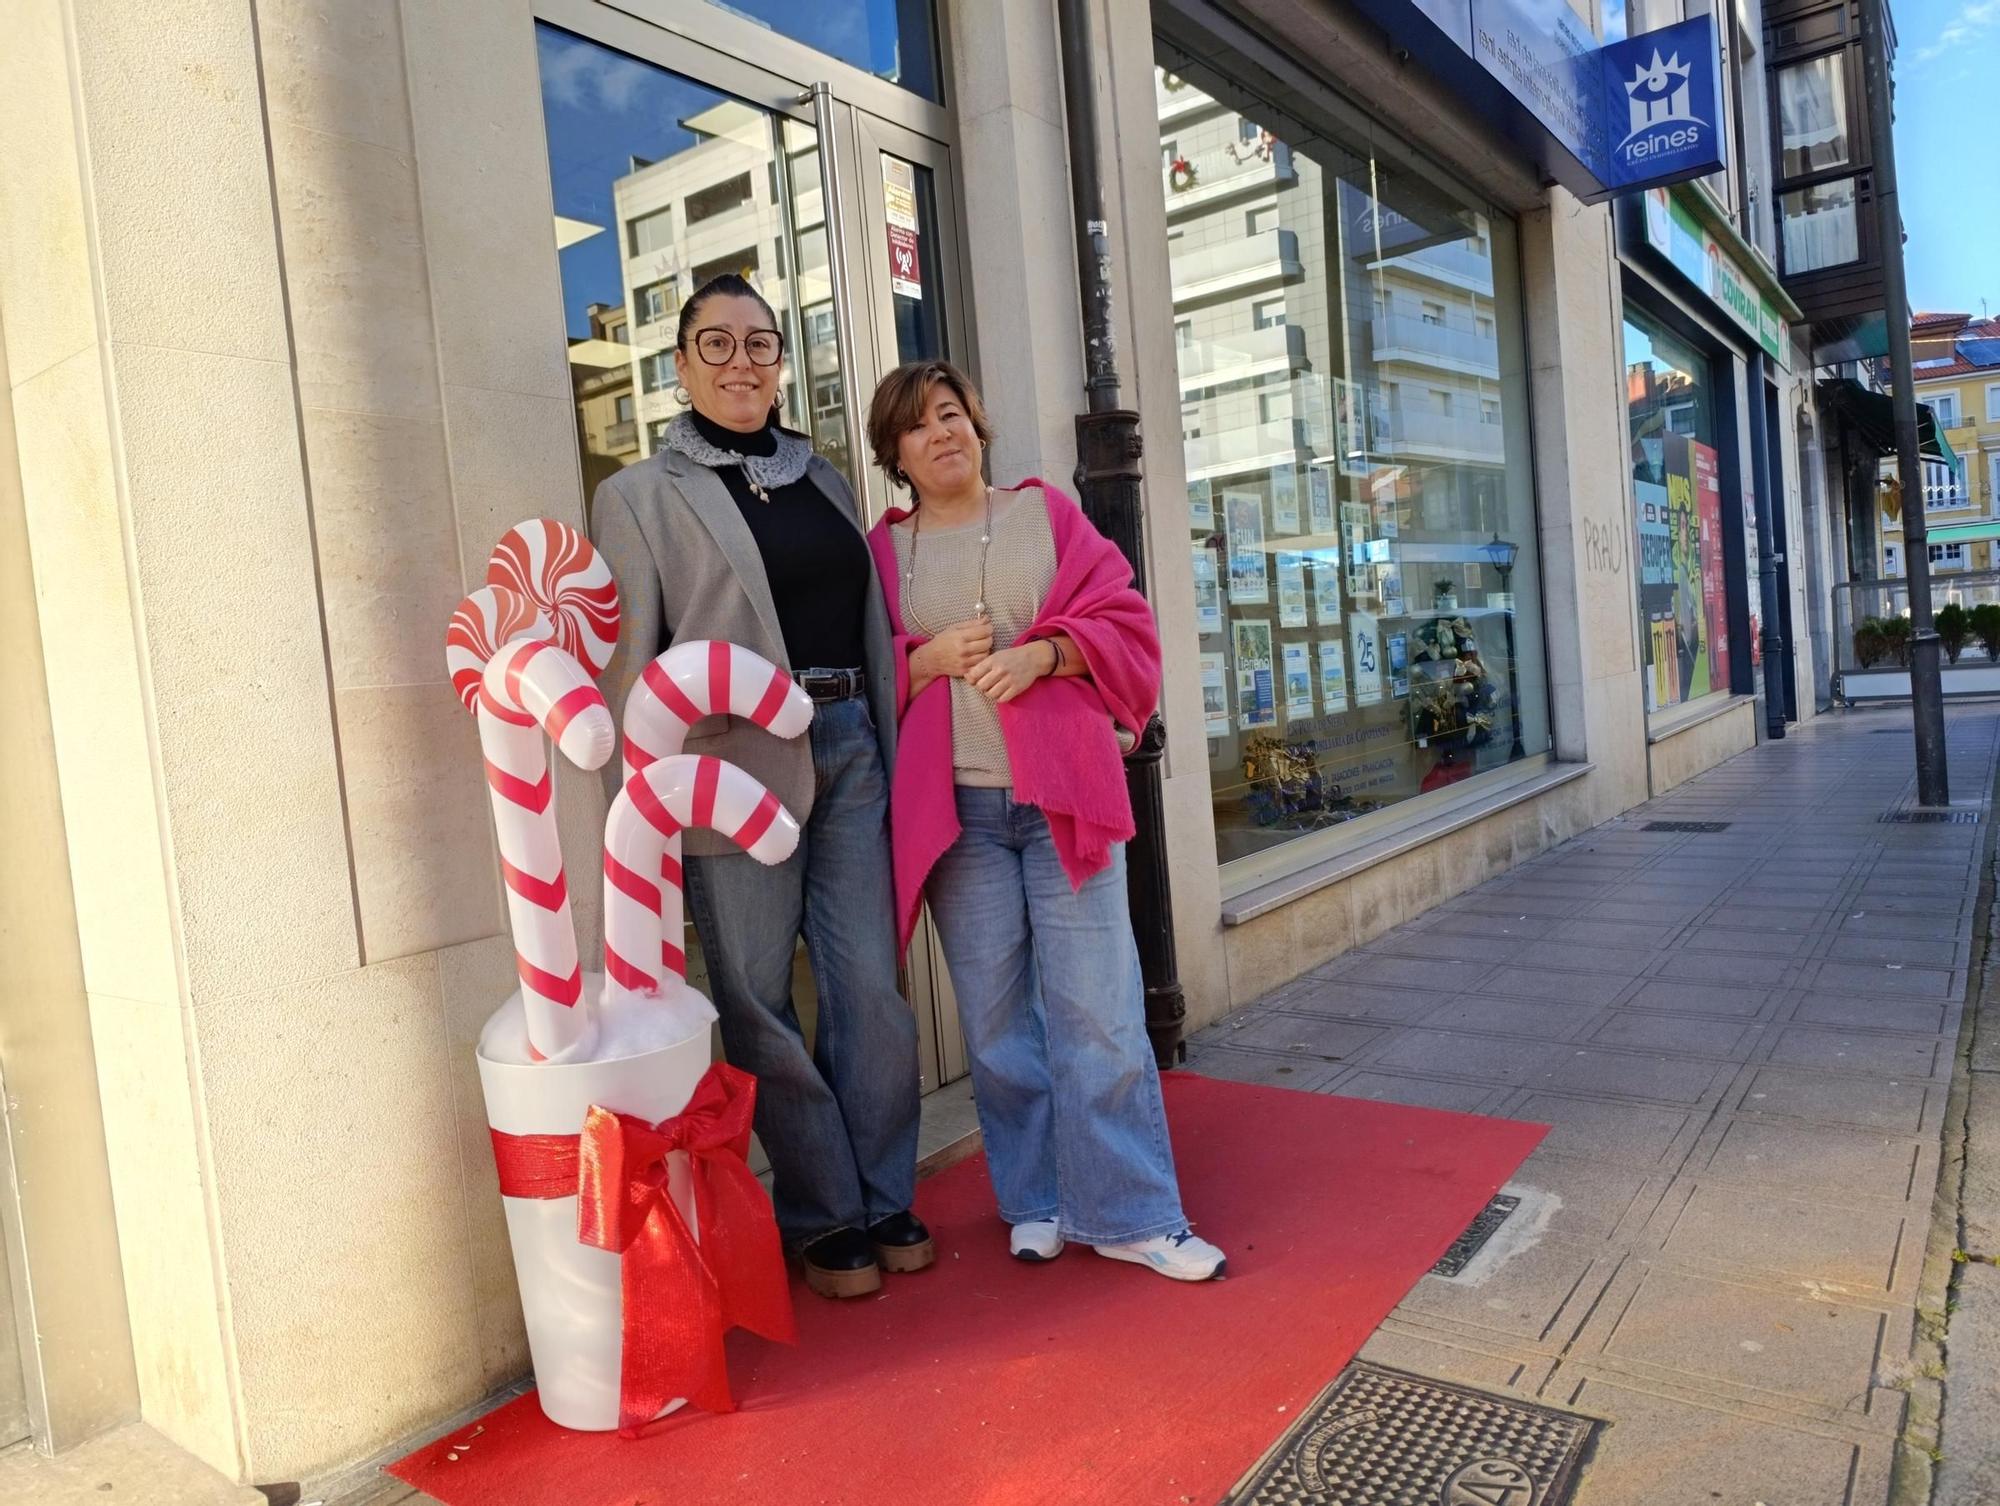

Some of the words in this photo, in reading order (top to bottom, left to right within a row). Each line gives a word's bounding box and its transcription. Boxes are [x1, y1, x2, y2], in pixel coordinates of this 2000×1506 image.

[1625, 126, 1699, 161] reines
[1357, 637, 1376, 673] 25
[1458, 1463, 1529, 1506] AS
